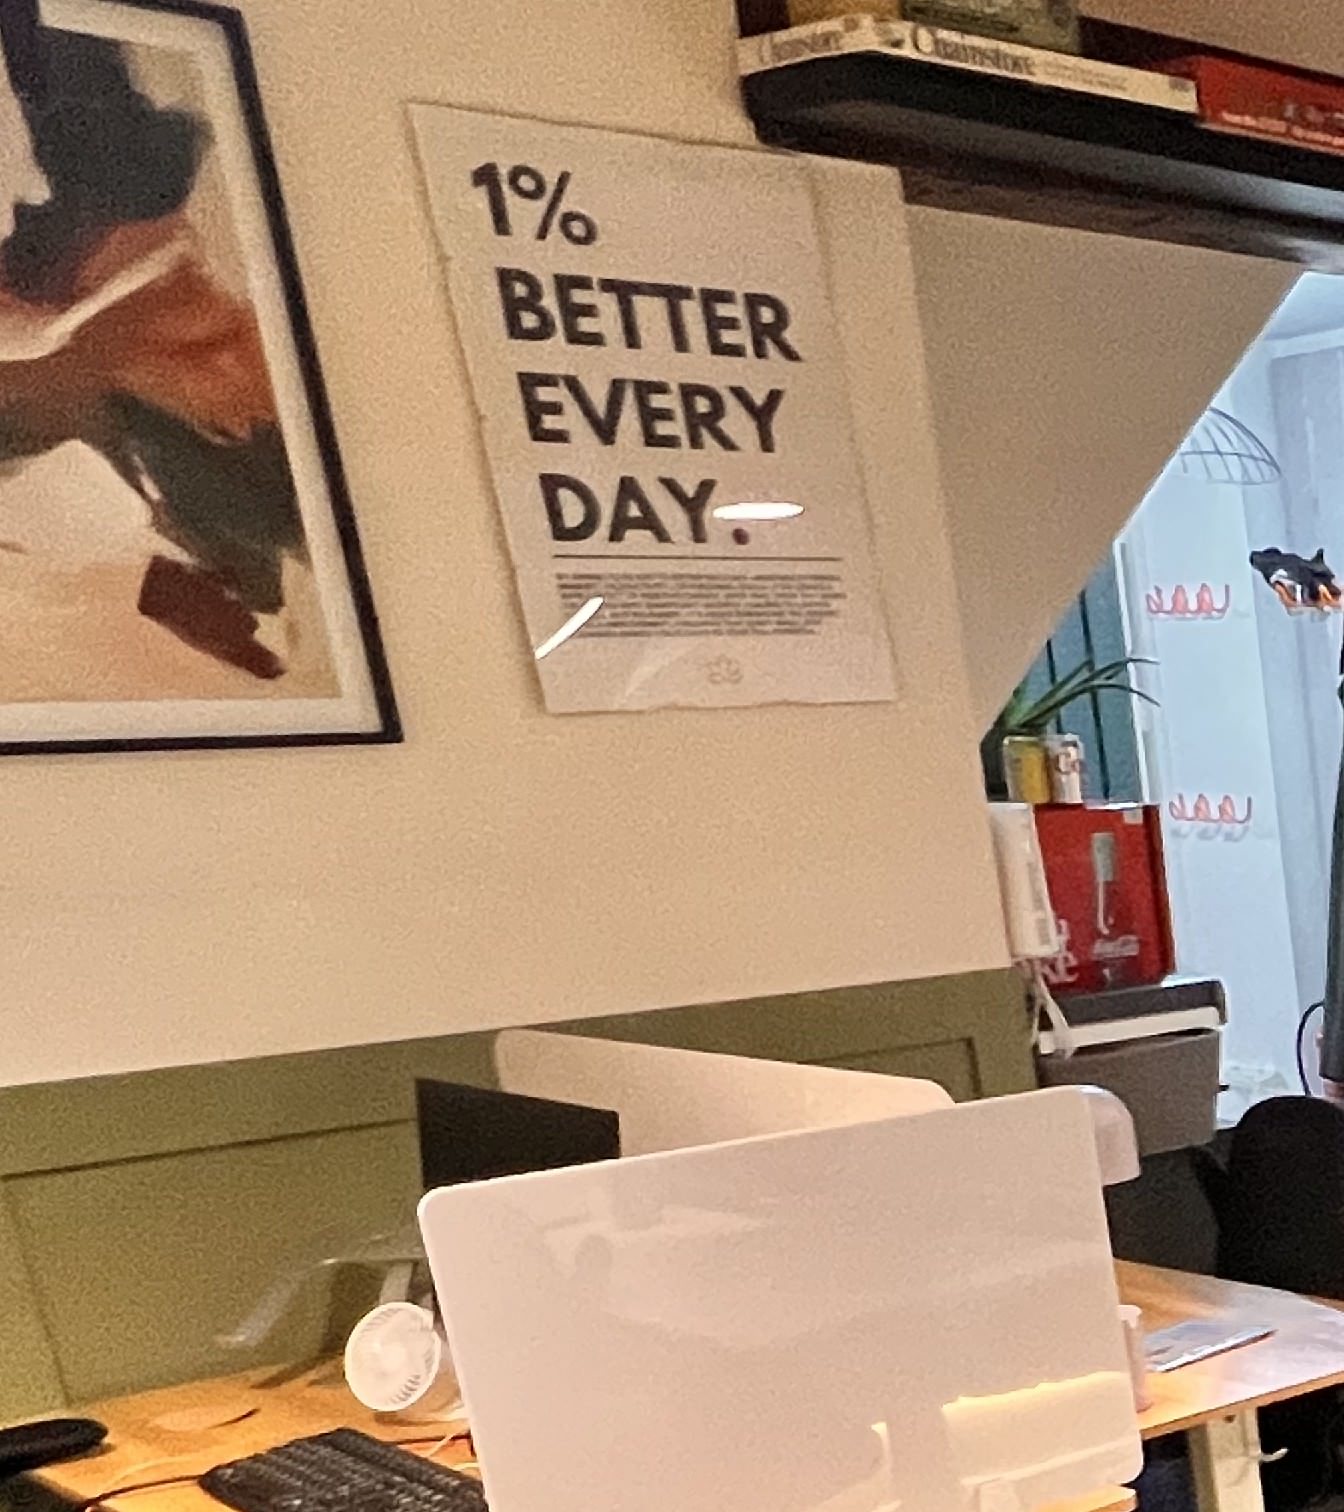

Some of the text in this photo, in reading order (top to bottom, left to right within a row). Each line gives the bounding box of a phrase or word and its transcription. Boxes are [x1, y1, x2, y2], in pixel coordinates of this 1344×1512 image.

[471, 161, 598, 246] 1%
[495, 266, 803, 363] BETTER
[516, 371, 785, 453] EVERY
[539, 473, 750, 545] DAY.
